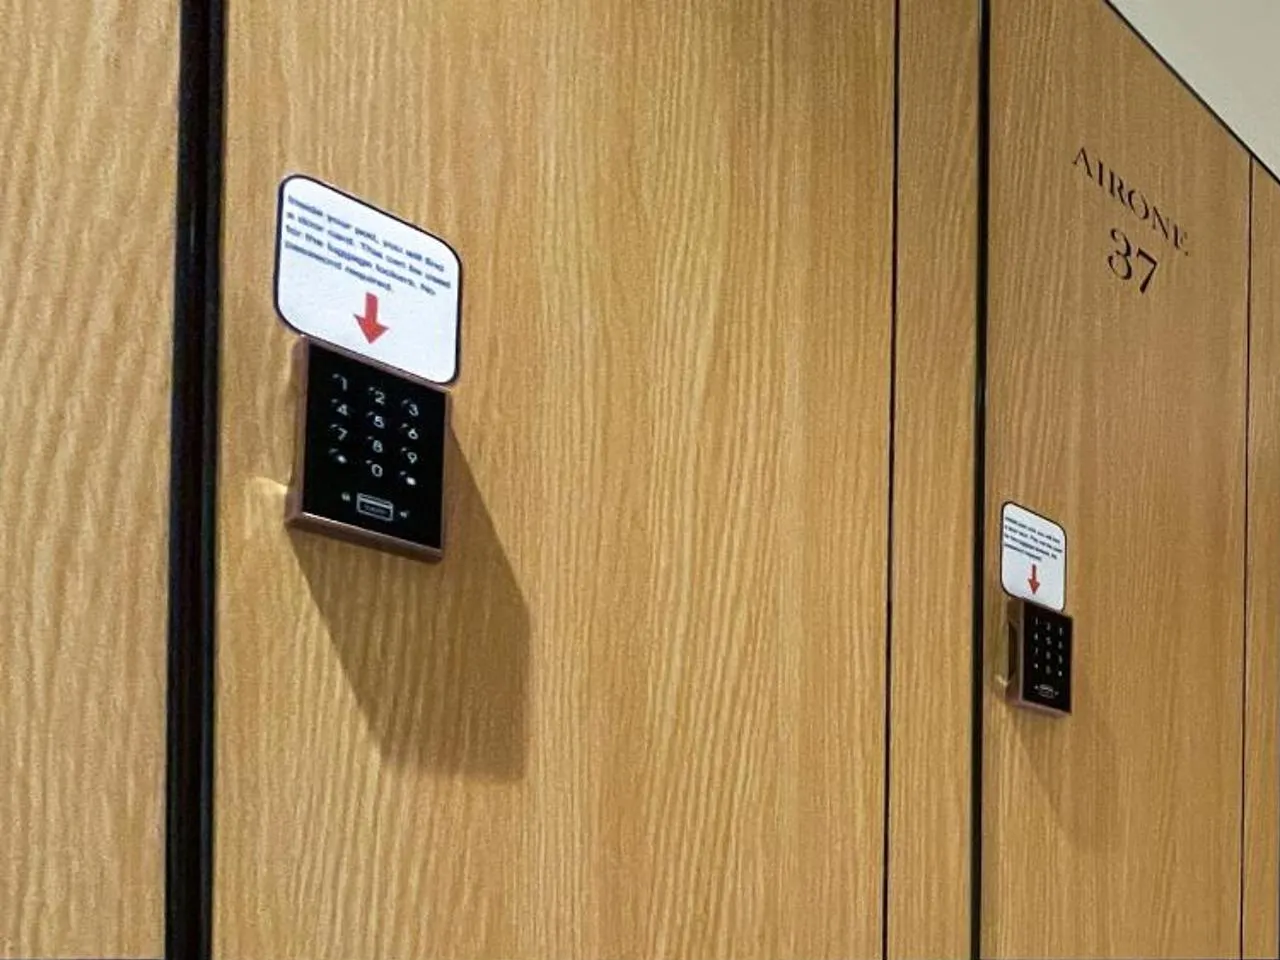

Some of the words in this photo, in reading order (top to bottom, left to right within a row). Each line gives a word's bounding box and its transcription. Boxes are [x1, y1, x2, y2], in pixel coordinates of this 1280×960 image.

[1072, 147, 1189, 256] AIRONE
[1108, 228, 1157, 294] 37
[336, 403, 349, 417] 4
[373, 415, 385, 429] 5
[408, 428, 419, 440] 6
[375, 390, 385, 405] 2
[408, 403, 419, 417] 3
[337, 427, 348, 441] 7
[372, 439, 383, 453] 8
[407, 451, 418, 464] 9
[371, 463, 383, 477] 0
